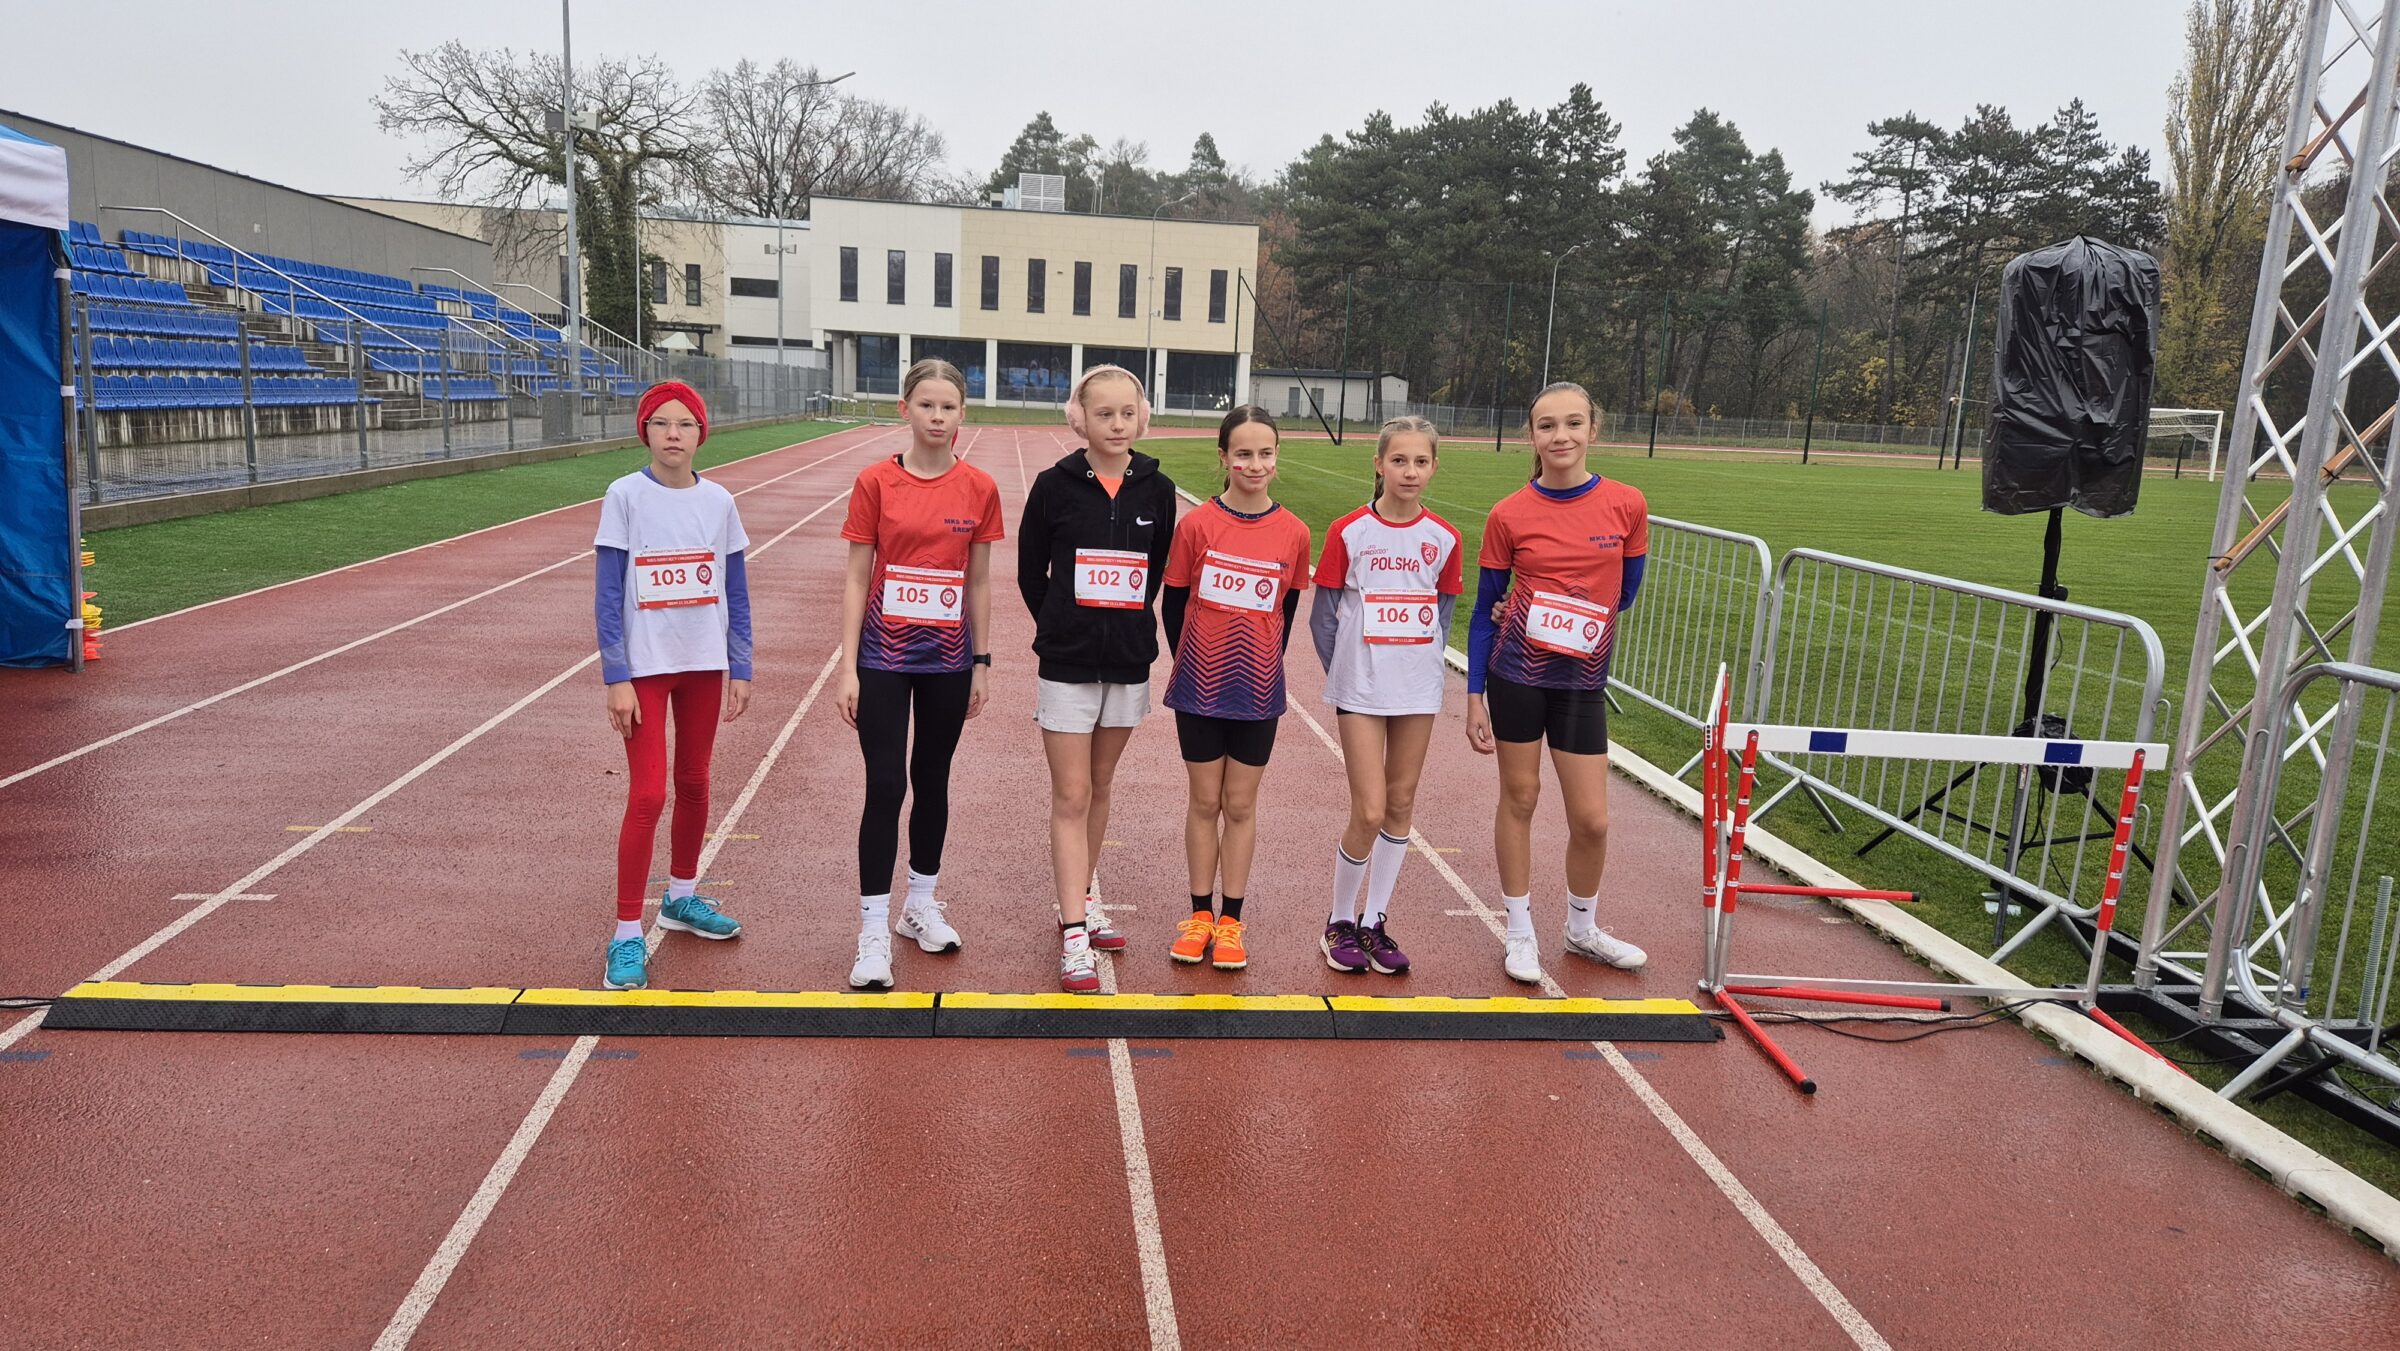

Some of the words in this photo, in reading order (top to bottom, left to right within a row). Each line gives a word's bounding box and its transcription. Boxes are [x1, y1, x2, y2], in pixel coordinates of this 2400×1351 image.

[1370, 556, 1420, 573] POLSKA
[650, 568, 687, 586] 103
[1088, 569, 1120, 586] 102
[1212, 572, 1246, 593] 109
[896, 586, 929, 604] 105
[1377, 607, 1409, 623] 106
[1540, 612, 1574, 633] 104
